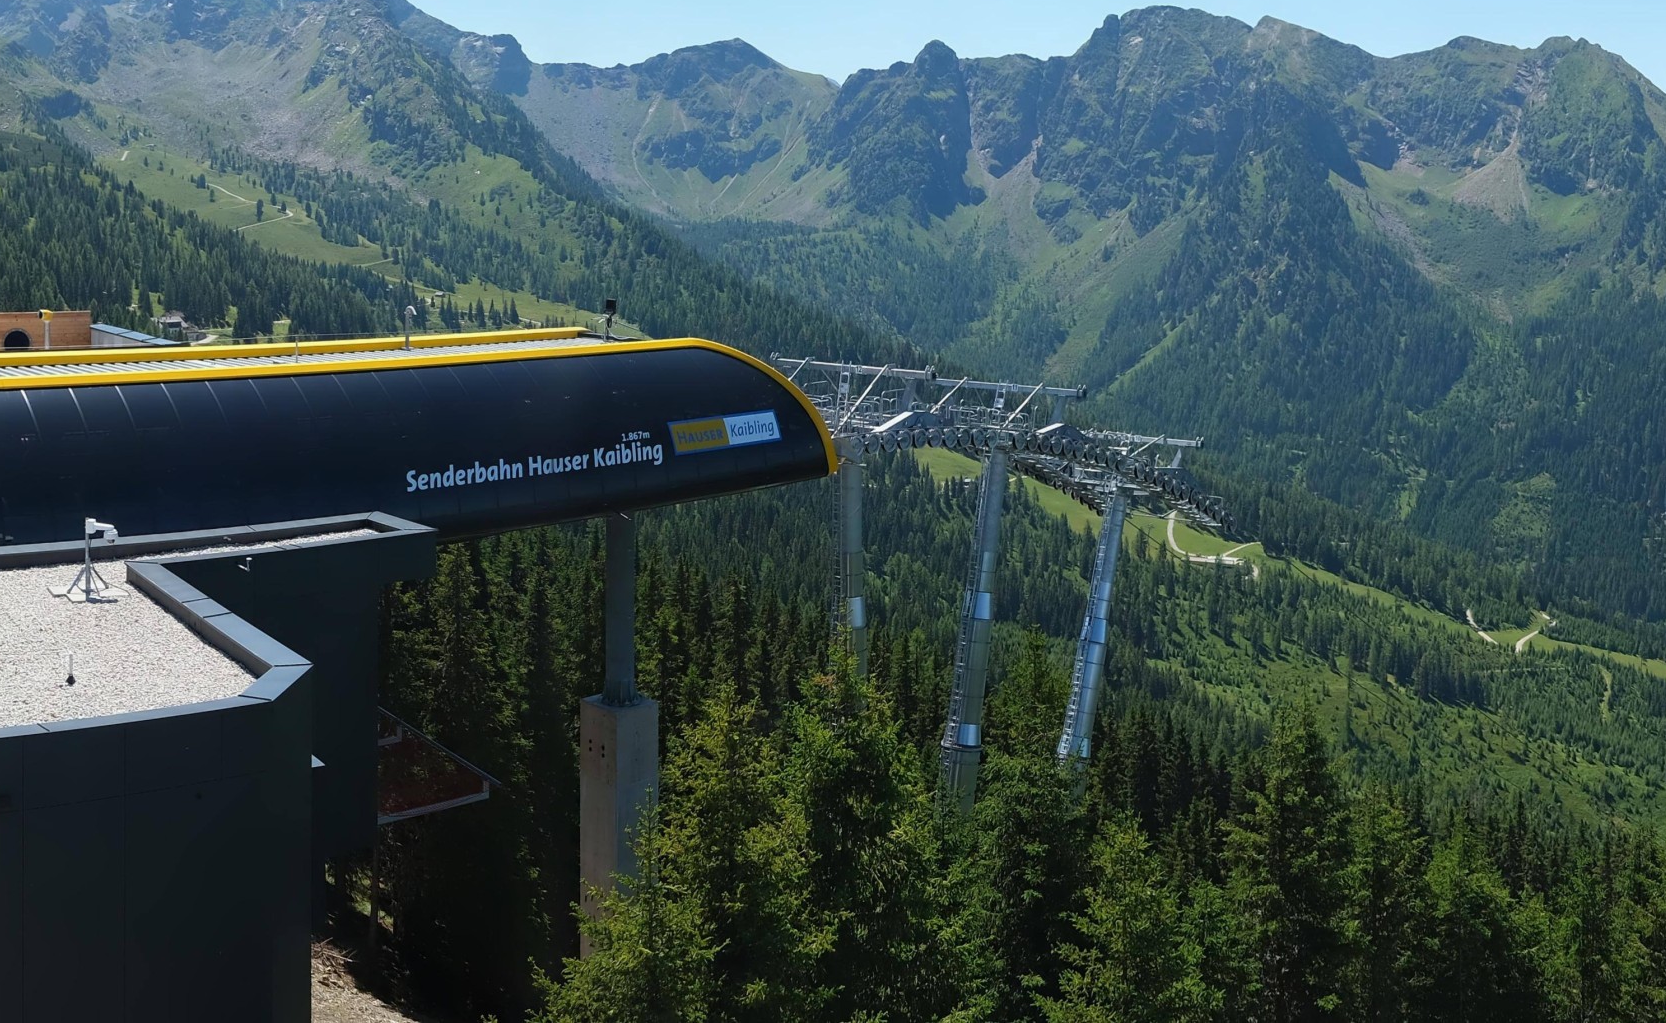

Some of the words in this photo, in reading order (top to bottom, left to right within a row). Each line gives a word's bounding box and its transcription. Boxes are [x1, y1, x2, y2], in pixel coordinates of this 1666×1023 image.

[621, 431, 651, 442] 1.867m
[677, 429, 724, 444] HAUSER
[730, 420, 775, 437] Kaibling
[406, 458, 523, 492] Senderbahn
[528, 453, 590, 477] Hauser
[593, 441, 663, 467] Kaibling
